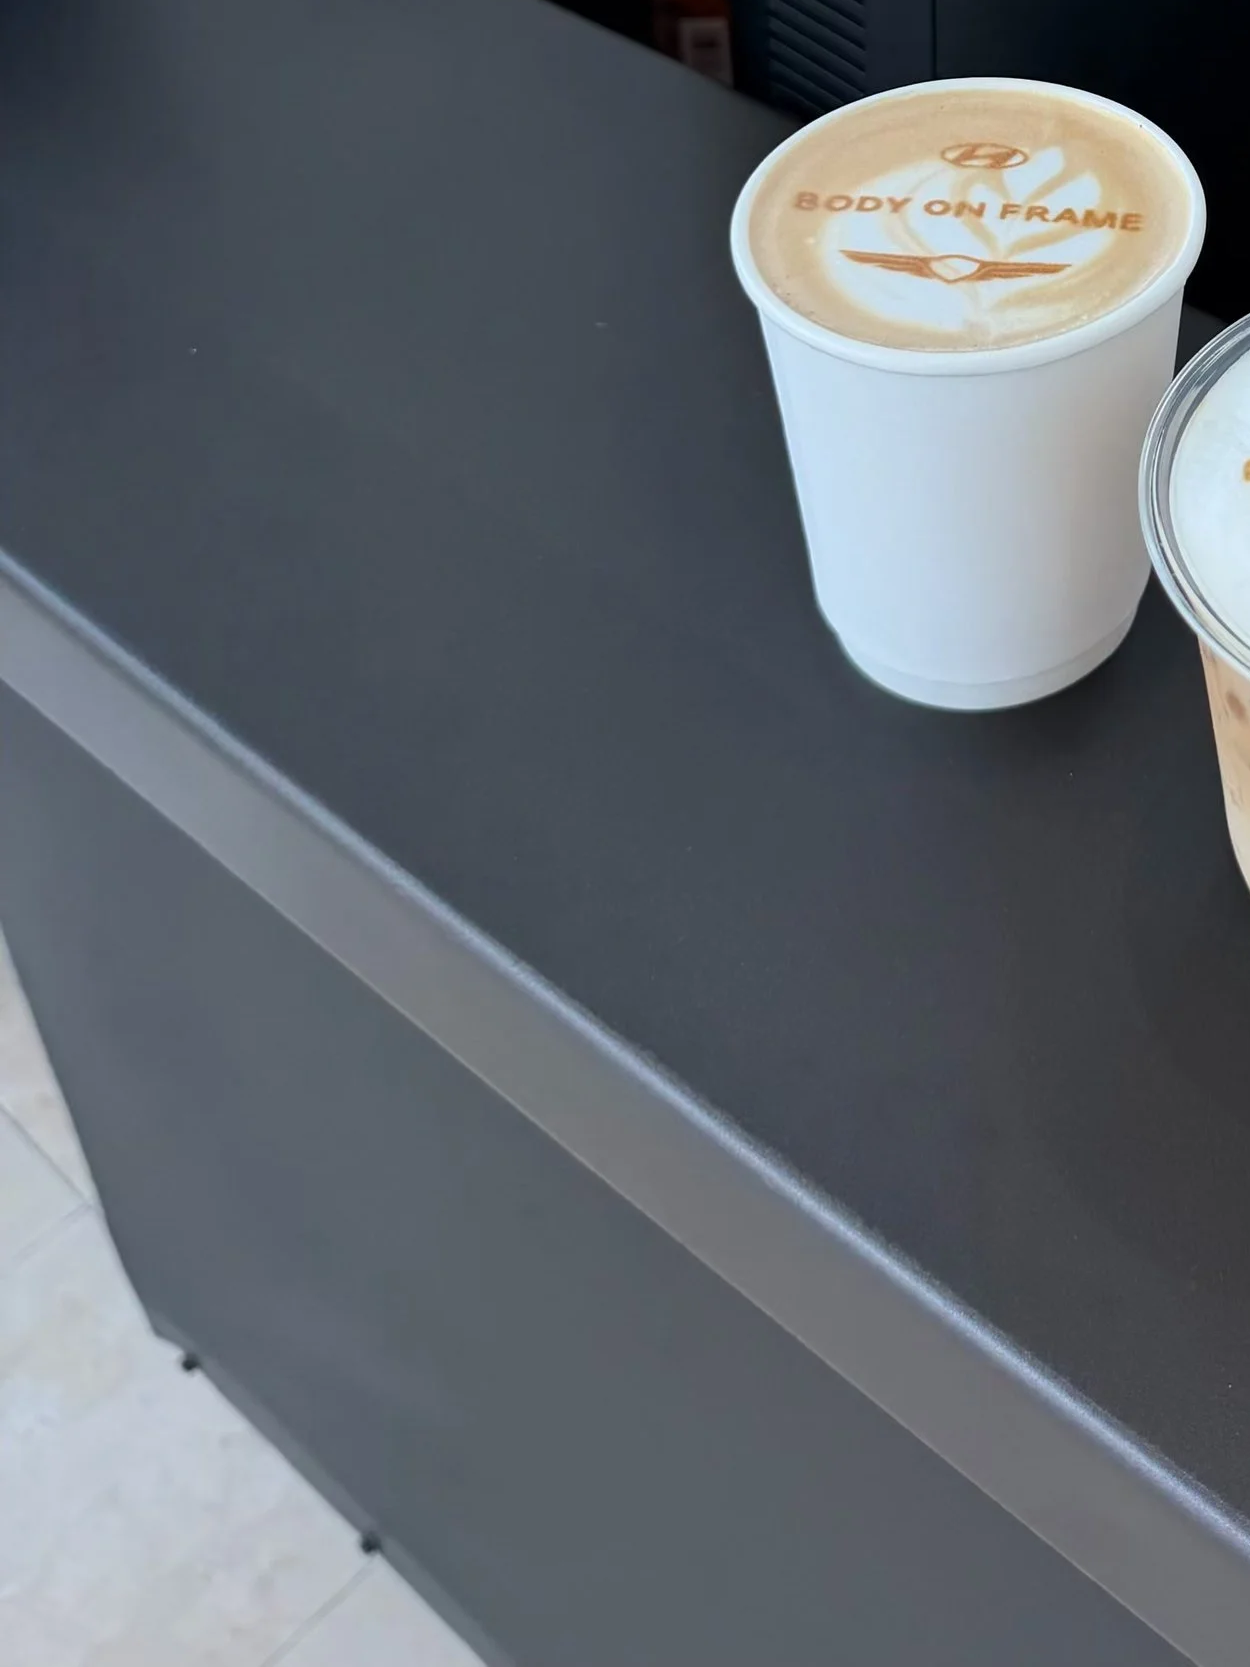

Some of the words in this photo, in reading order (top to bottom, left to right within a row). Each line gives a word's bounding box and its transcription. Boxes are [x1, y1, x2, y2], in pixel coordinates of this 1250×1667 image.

[794, 191, 911, 213] BODY
[923, 199, 987, 219] ON
[999, 202, 1146, 232] FRAME
